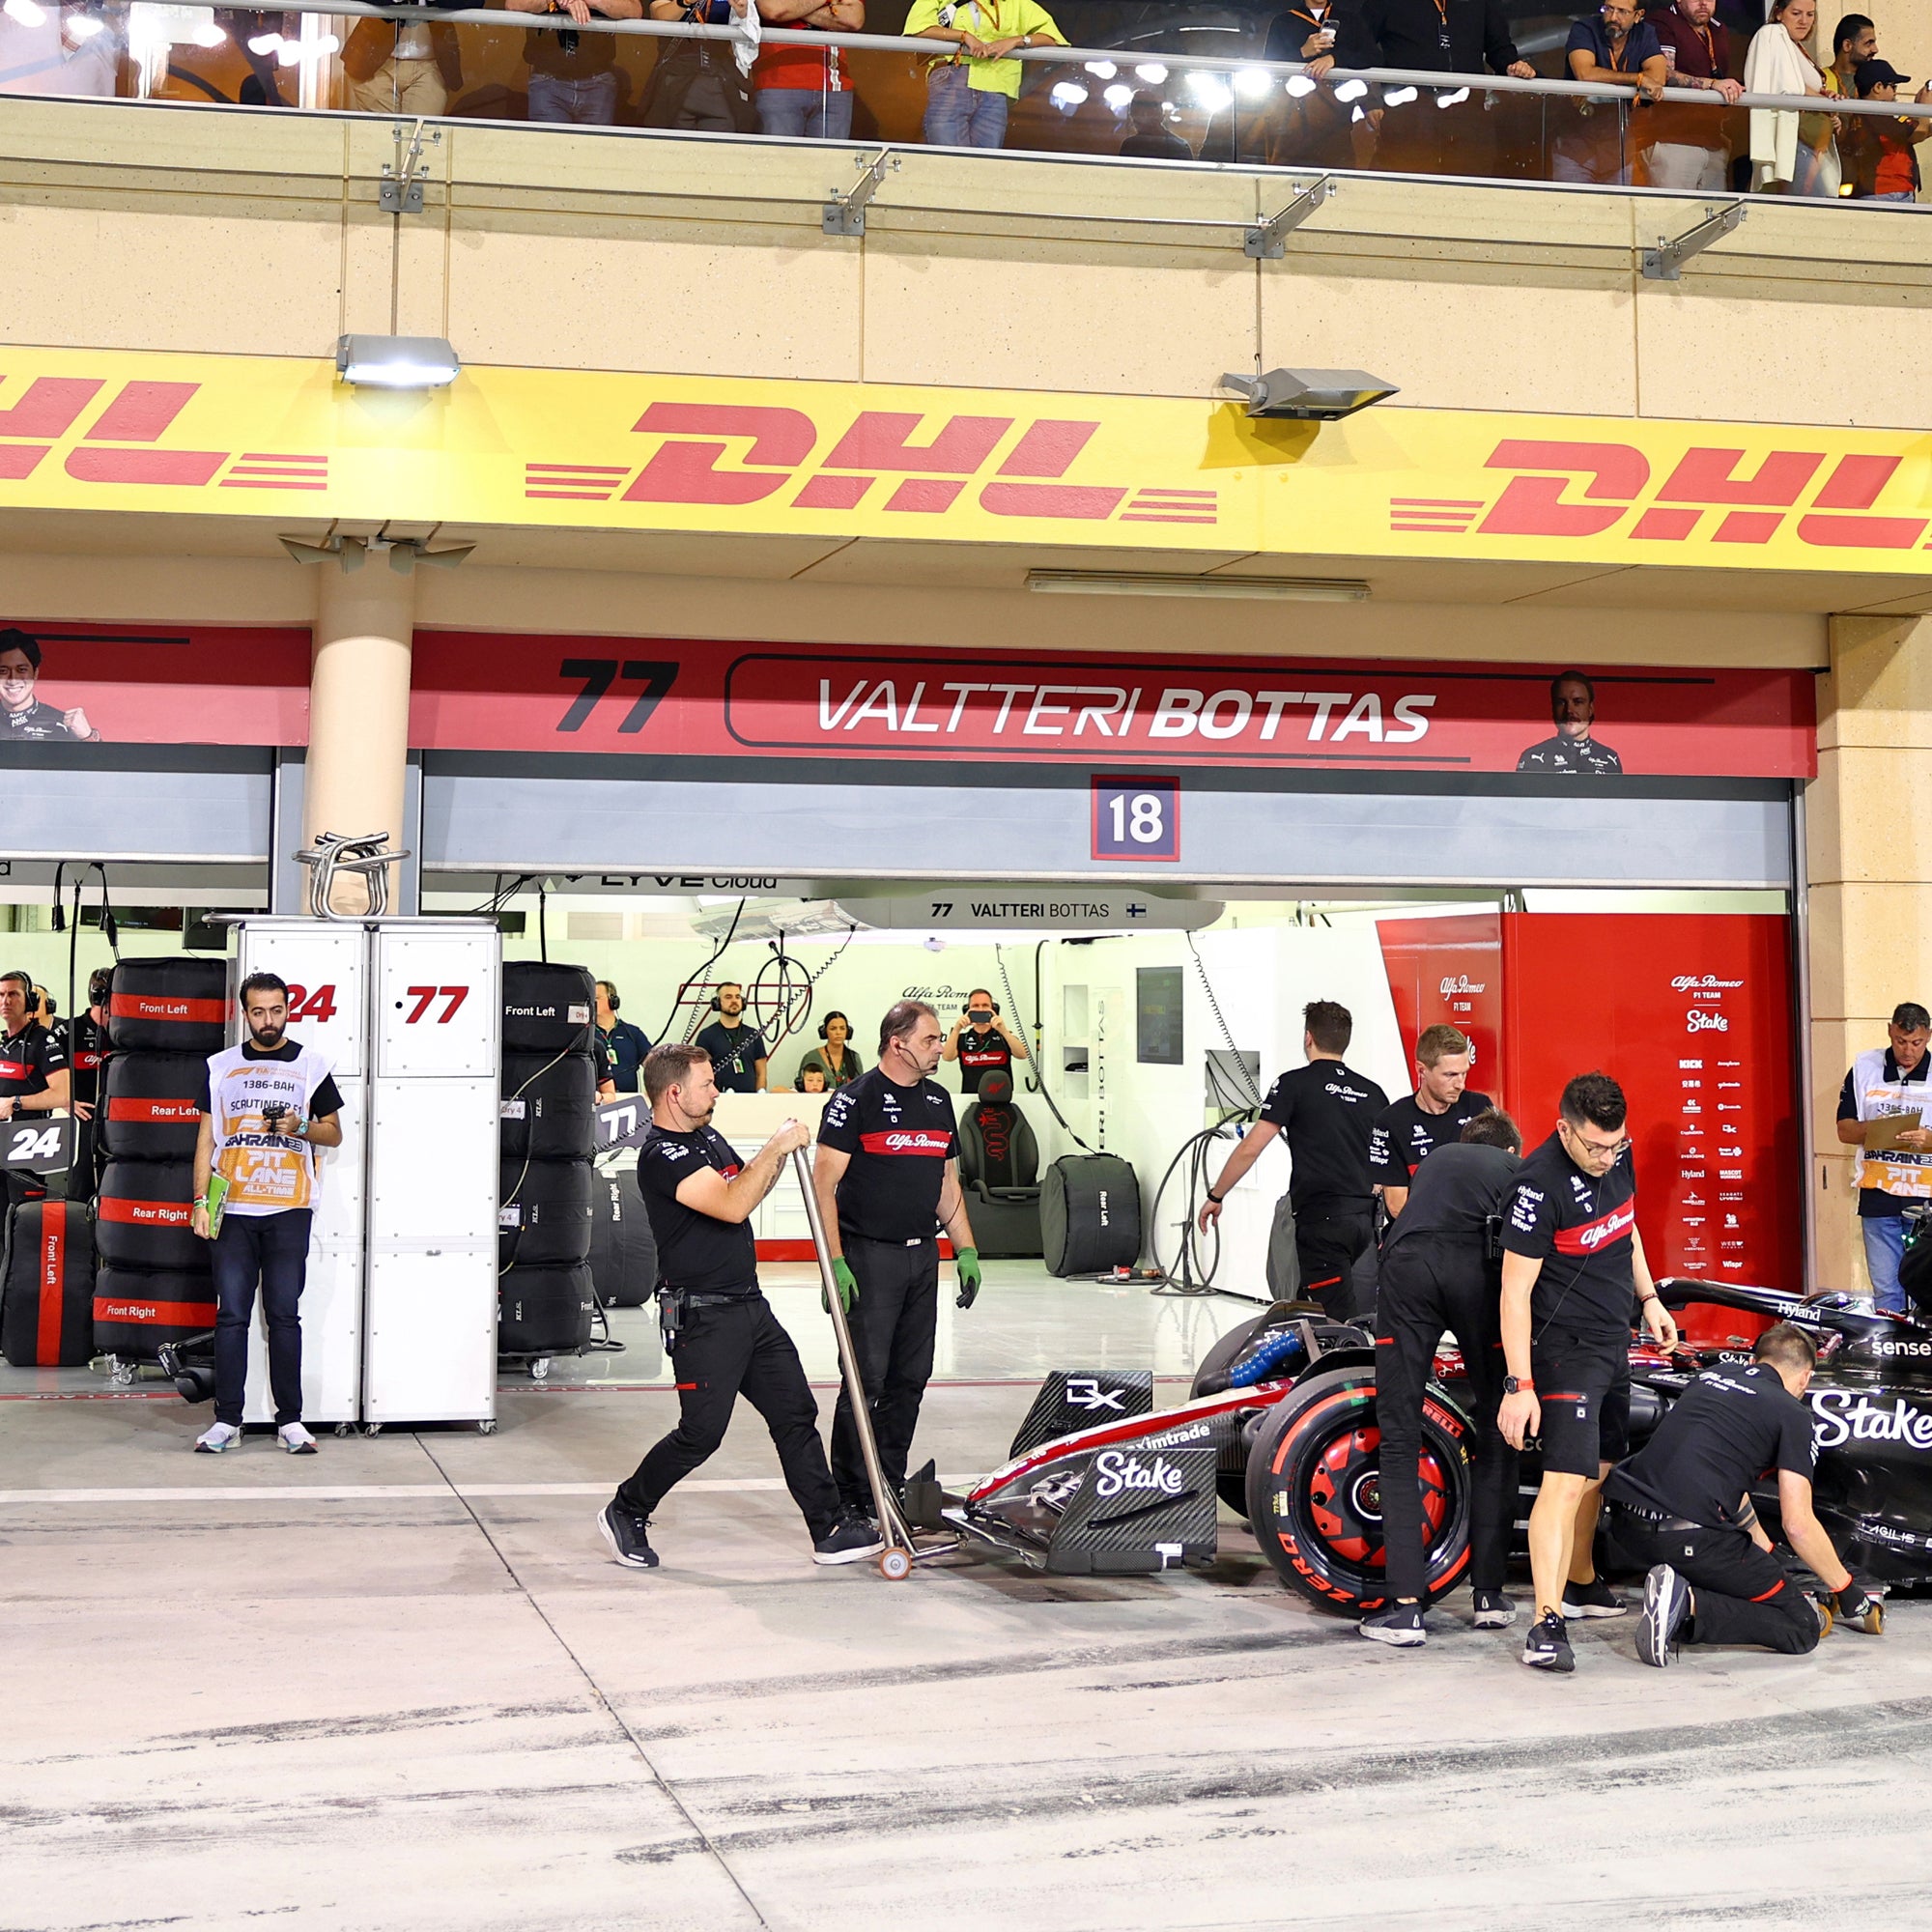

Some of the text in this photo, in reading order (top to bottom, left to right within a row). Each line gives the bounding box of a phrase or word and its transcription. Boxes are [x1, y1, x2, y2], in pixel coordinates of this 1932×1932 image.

[0, 375, 231, 486] HL
[620, 401, 1129, 520] DHL
[1476, 439, 1930, 550] DHL
[556, 659, 1437, 744] 77 VALTTERI BOTTAS
[1109, 794, 1164, 844] 18
[931, 903, 1110, 918] 77 VALTTERI BOTTAS
[935, 985, 969, 998] Rom
[1439, 974, 1485, 1001] Alfa Romeo
[1671, 974, 1744, 992] Alfa Romeo
[140, 1003, 187, 1015] Front Left
[286, 983, 337, 1023] 24
[405, 985, 470, 1024] 77
[505, 1005, 556, 1017] Front Left
[1687, 1009, 1728, 1033] Stake
[243, 1080, 295, 1093] 1386-BAH
[151, 1105, 176, 1117] Rear
[600, 1104, 637, 1143] 77
[8, 1126, 62, 1161] 24
[886, 1133, 949, 1151] Alfa Romeo
[247, 1150, 287, 1168] PIT
[235, 1165, 298, 1185] LANE
[1681, 1169, 1705, 1179] Hyland
[1886, 1166, 1922, 1182] PIT
[1518, 1185, 1545, 1202] Hyland
[1877, 1179, 1931, 1199] LANE
[132, 1207, 188, 1221] Rear Right
[1099, 1190, 1109, 1227] Rear Left
[1580, 1223, 1608, 1248] Alfa
[46, 1236, 58, 1285] Front Left
[1722, 1260, 1744, 1268] Wispr
[106, 1304, 156, 1319] Front Right
[1777, 1301, 1822, 1322] Hyland
[1871, 1341, 1932, 1356] sense
[1422, 1404, 1463, 1438] RELLI
[1811, 1389, 1932, 1450] Stake
[1126, 1424, 1210, 1449] ximtrade
[1095, 1451, 1183, 1496] Stake
[1276, 1531, 1355, 1605] ZERO
